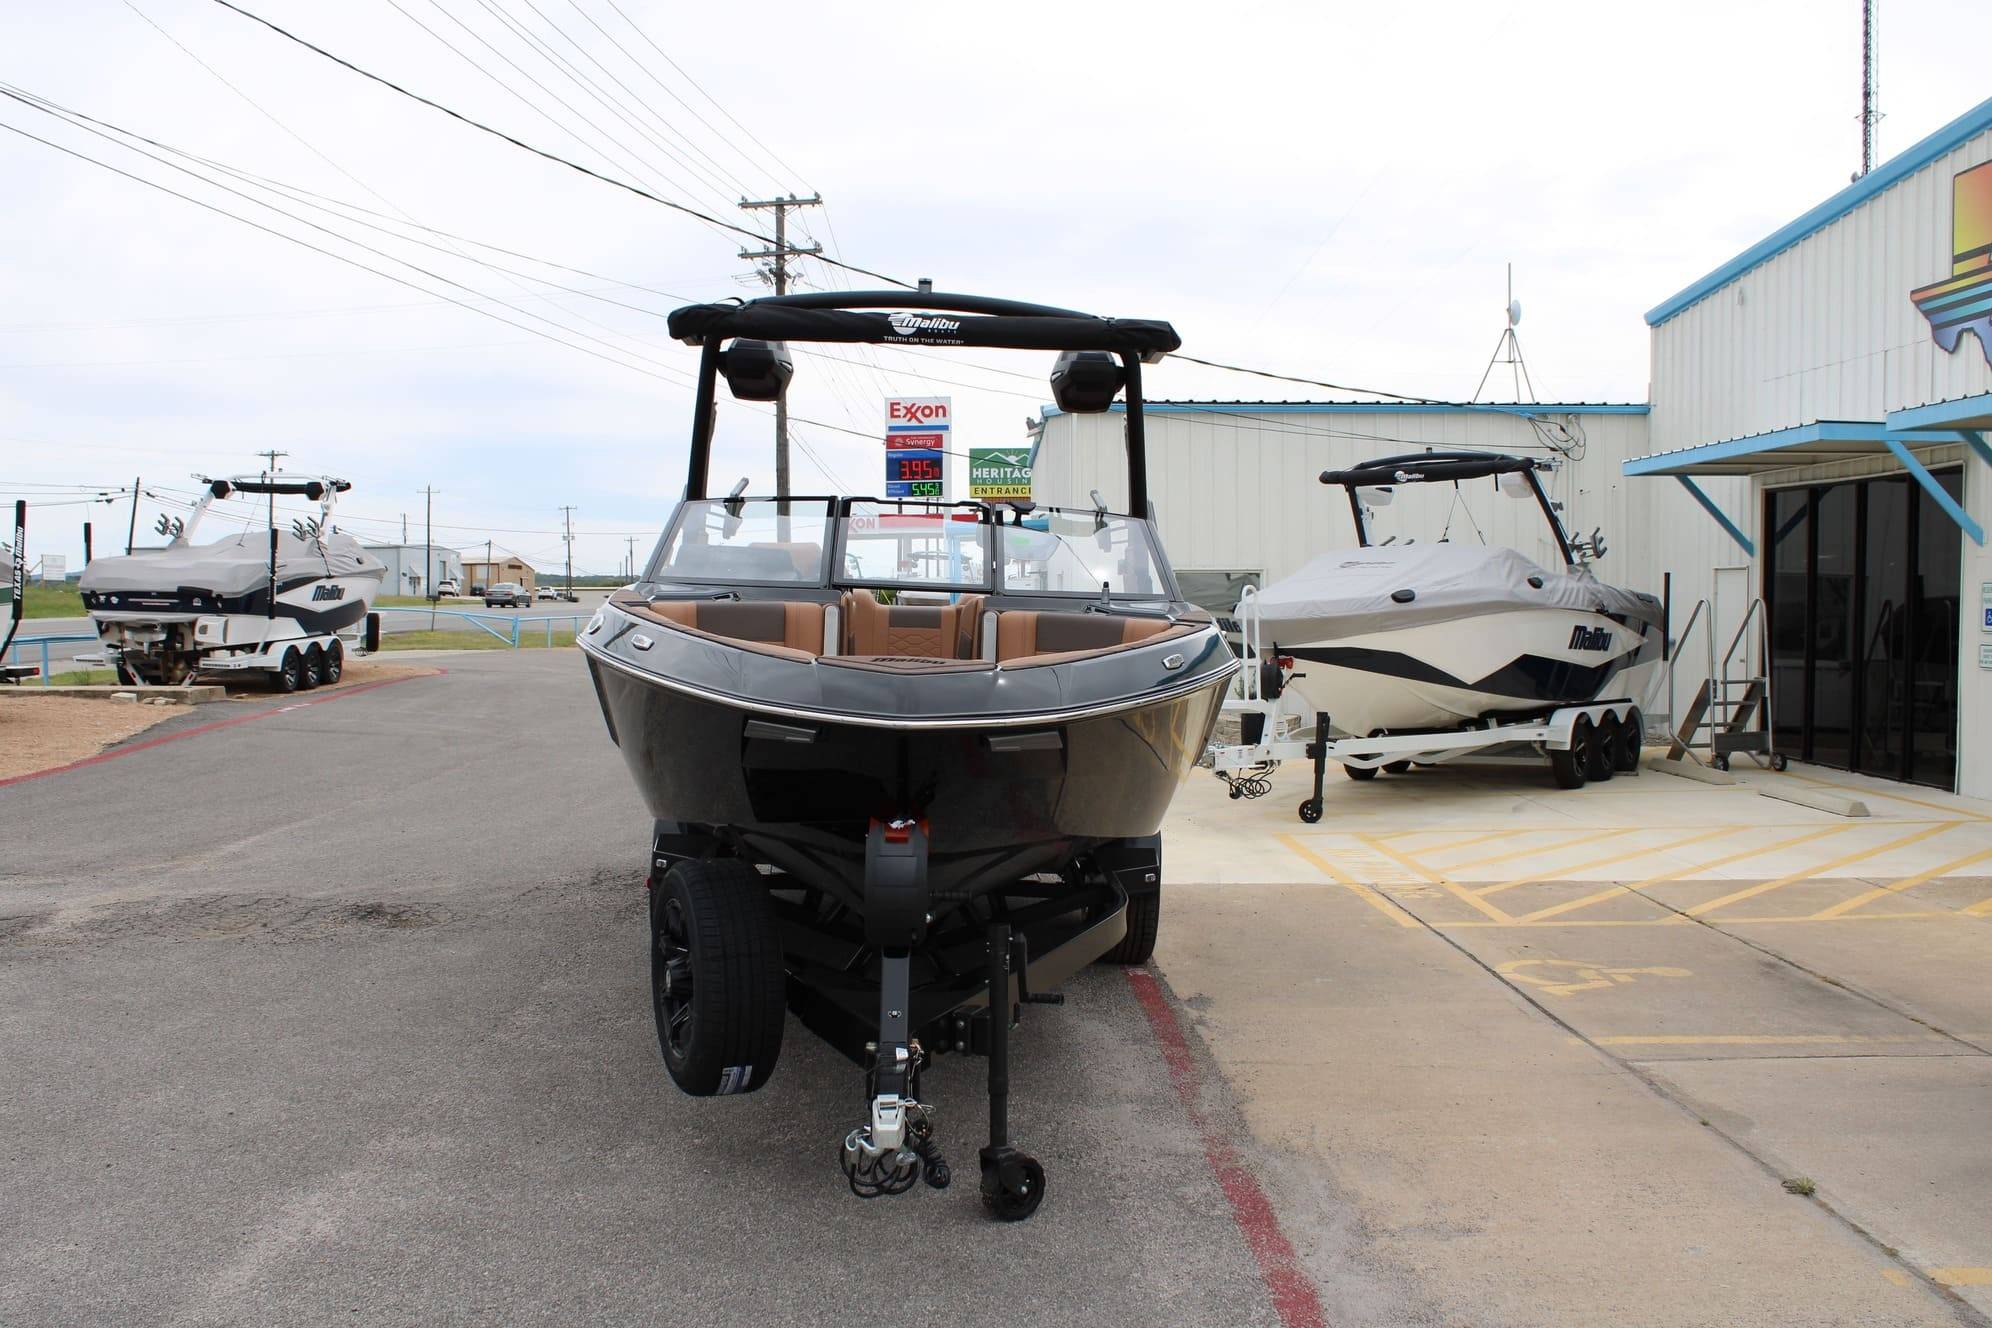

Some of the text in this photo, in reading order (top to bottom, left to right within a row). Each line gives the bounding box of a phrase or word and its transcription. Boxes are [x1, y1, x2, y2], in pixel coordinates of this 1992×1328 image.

[902, 317, 960, 330] Malibu
[890, 402, 947, 424] Exxon
[905, 438, 936, 447] Synergy
[972, 467, 1031, 478] HERITAG
[13, 569, 22, 600] TEXAS
[311, 585, 346, 601] Malibu
[1568, 624, 1612, 651] Malibu
